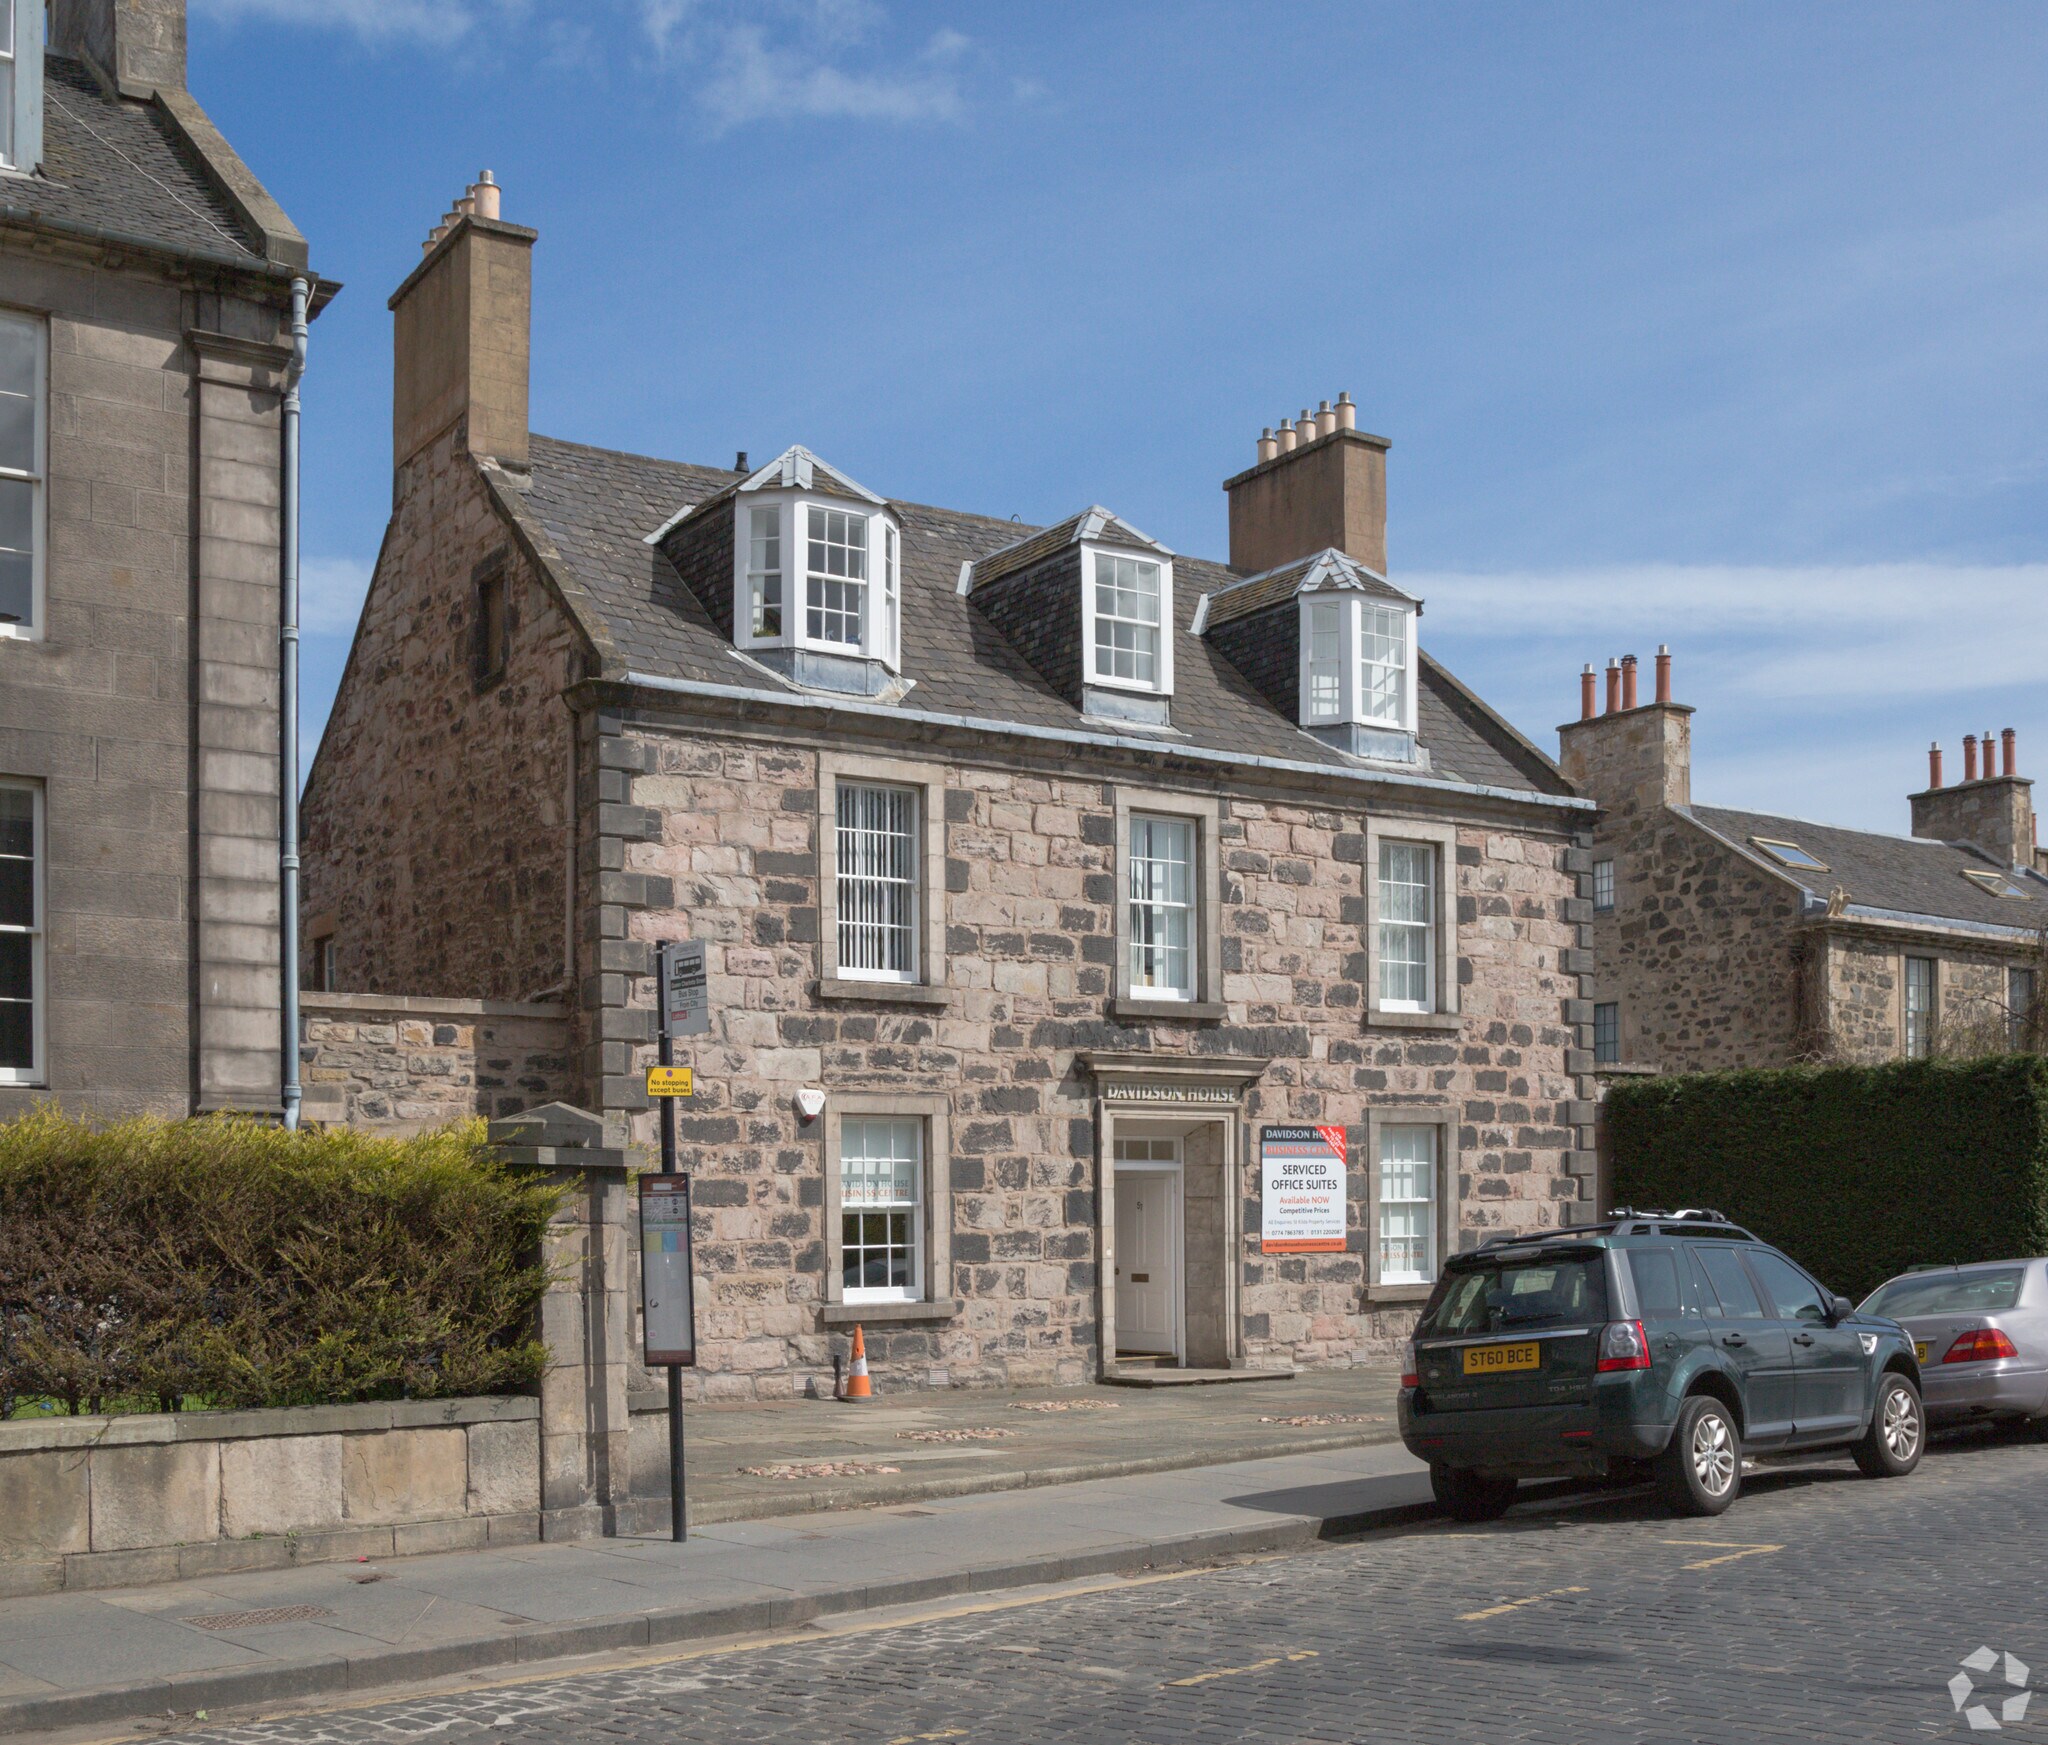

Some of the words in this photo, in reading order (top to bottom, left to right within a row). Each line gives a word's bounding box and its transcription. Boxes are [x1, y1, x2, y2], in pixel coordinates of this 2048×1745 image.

[678, 990, 687, 998] Bus
[688, 989, 699, 998] Stop
[1107, 1083, 1183, 1100] DAVIDSON
[1187, 1087, 1236, 1102] HOUSE
[1266, 1129, 1310, 1139] DAVIDSON
[1266, 1145, 1308, 1155] BUSINESS
[1310, 1145, 1335, 1155] CENT
[1282, 1164, 1327, 1175] SERVICED
[1271, 1179, 1304, 1190] OFFICE
[1306, 1179, 1338, 1190] SUITES
[1279, 1196, 1310, 1204] Available
[1312, 1196, 1330, 1204] NOW
[1279, 1207, 1313, 1215] Competitive
[1470, 1351, 1504, 1367] ST60
[1507, 1348, 1534, 1364] BCE
